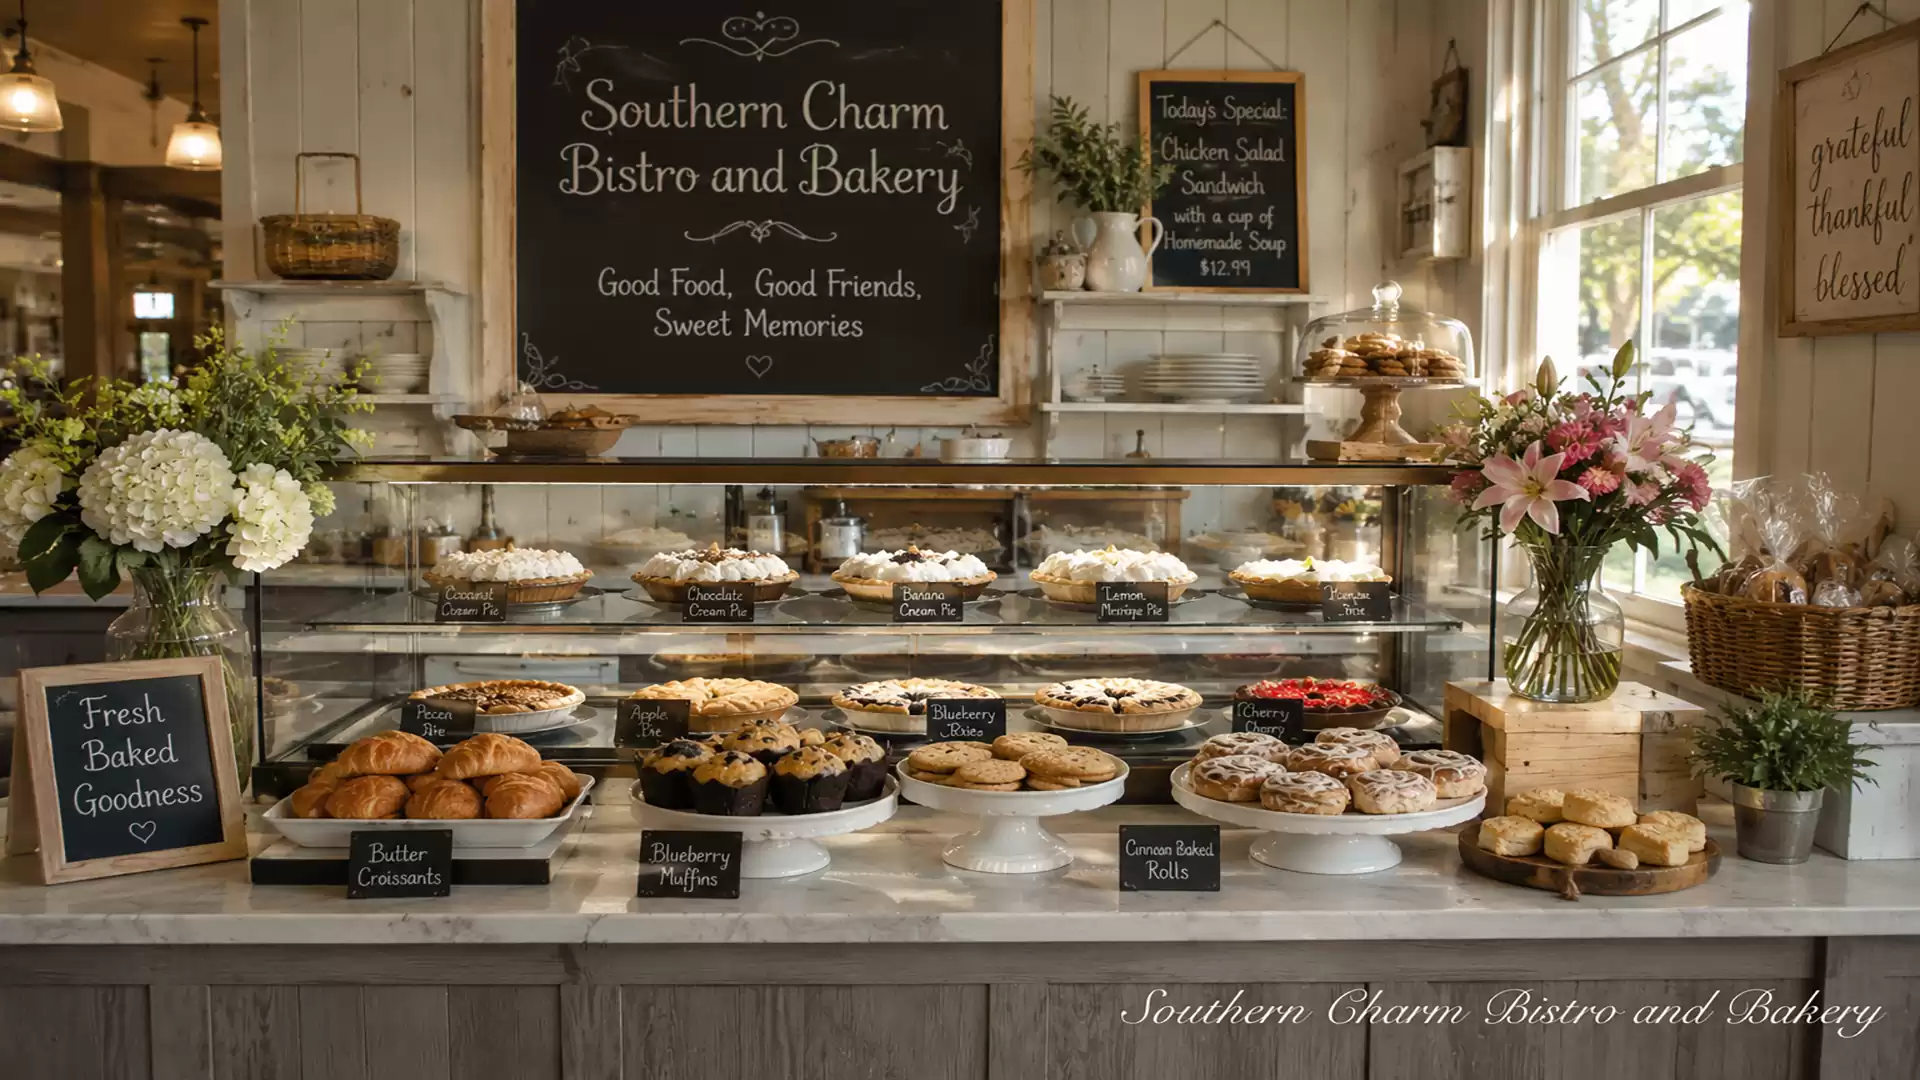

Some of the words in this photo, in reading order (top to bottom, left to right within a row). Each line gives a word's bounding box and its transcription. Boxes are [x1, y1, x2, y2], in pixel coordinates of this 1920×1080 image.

[581, 78, 787, 131] Southern
[802, 80, 948, 131] Charm
[1156, 94, 1216, 127] Today's
[1161, 136, 1229, 162] Chicken
[1235, 137, 1286, 162] Salad
[1809, 96, 1912, 192] grateful
[559, 143, 699, 196] Bistro
[711, 149, 787, 193] and
[799, 143, 963, 214] Bakery
[1181, 170, 1265, 195] Sandwich
[1174, 205, 1206, 223] with
[1212, 211, 1223, 223] a
[1228, 211, 1254, 231] cup
[1259, 206, 1275, 230] of
[1806, 171, 1913, 245] thankful
[1164, 230, 1242, 251] Homemade
[1249, 230, 1286, 259] Soup
[1200, 258, 1251, 277] $12.99
[1815, 242, 1906, 302] blessed
[598, 267, 659, 296] Good
[670, 267, 733, 300] Food,
[755, 268, 816, 298] Good
[827, 268, 922, 301] Friends,
[653, 307, 732, 337] Sweet
[743, 308, 863, 338] Memories
[900, 585, 945, 601] Banana
[689, 602, 726, 616] Cream
[941, 602, 957, 616] Pie
[79, 692, 166, 730] Fresh
[629, 704, 668, 725] Apple
[80, 733, 180, 772] Baked
[74, 778, 203, 818] Goodness
[368, 842, 428, 863] Butter
[648, 842, 731, 870] Blueberry
[1175, 840, 1214, 856] Baked
[357, 866, 442, 887] Croissants
[660, 866, 718, 892] Muffins
[1145, 859, 1190, 880] Rolls
